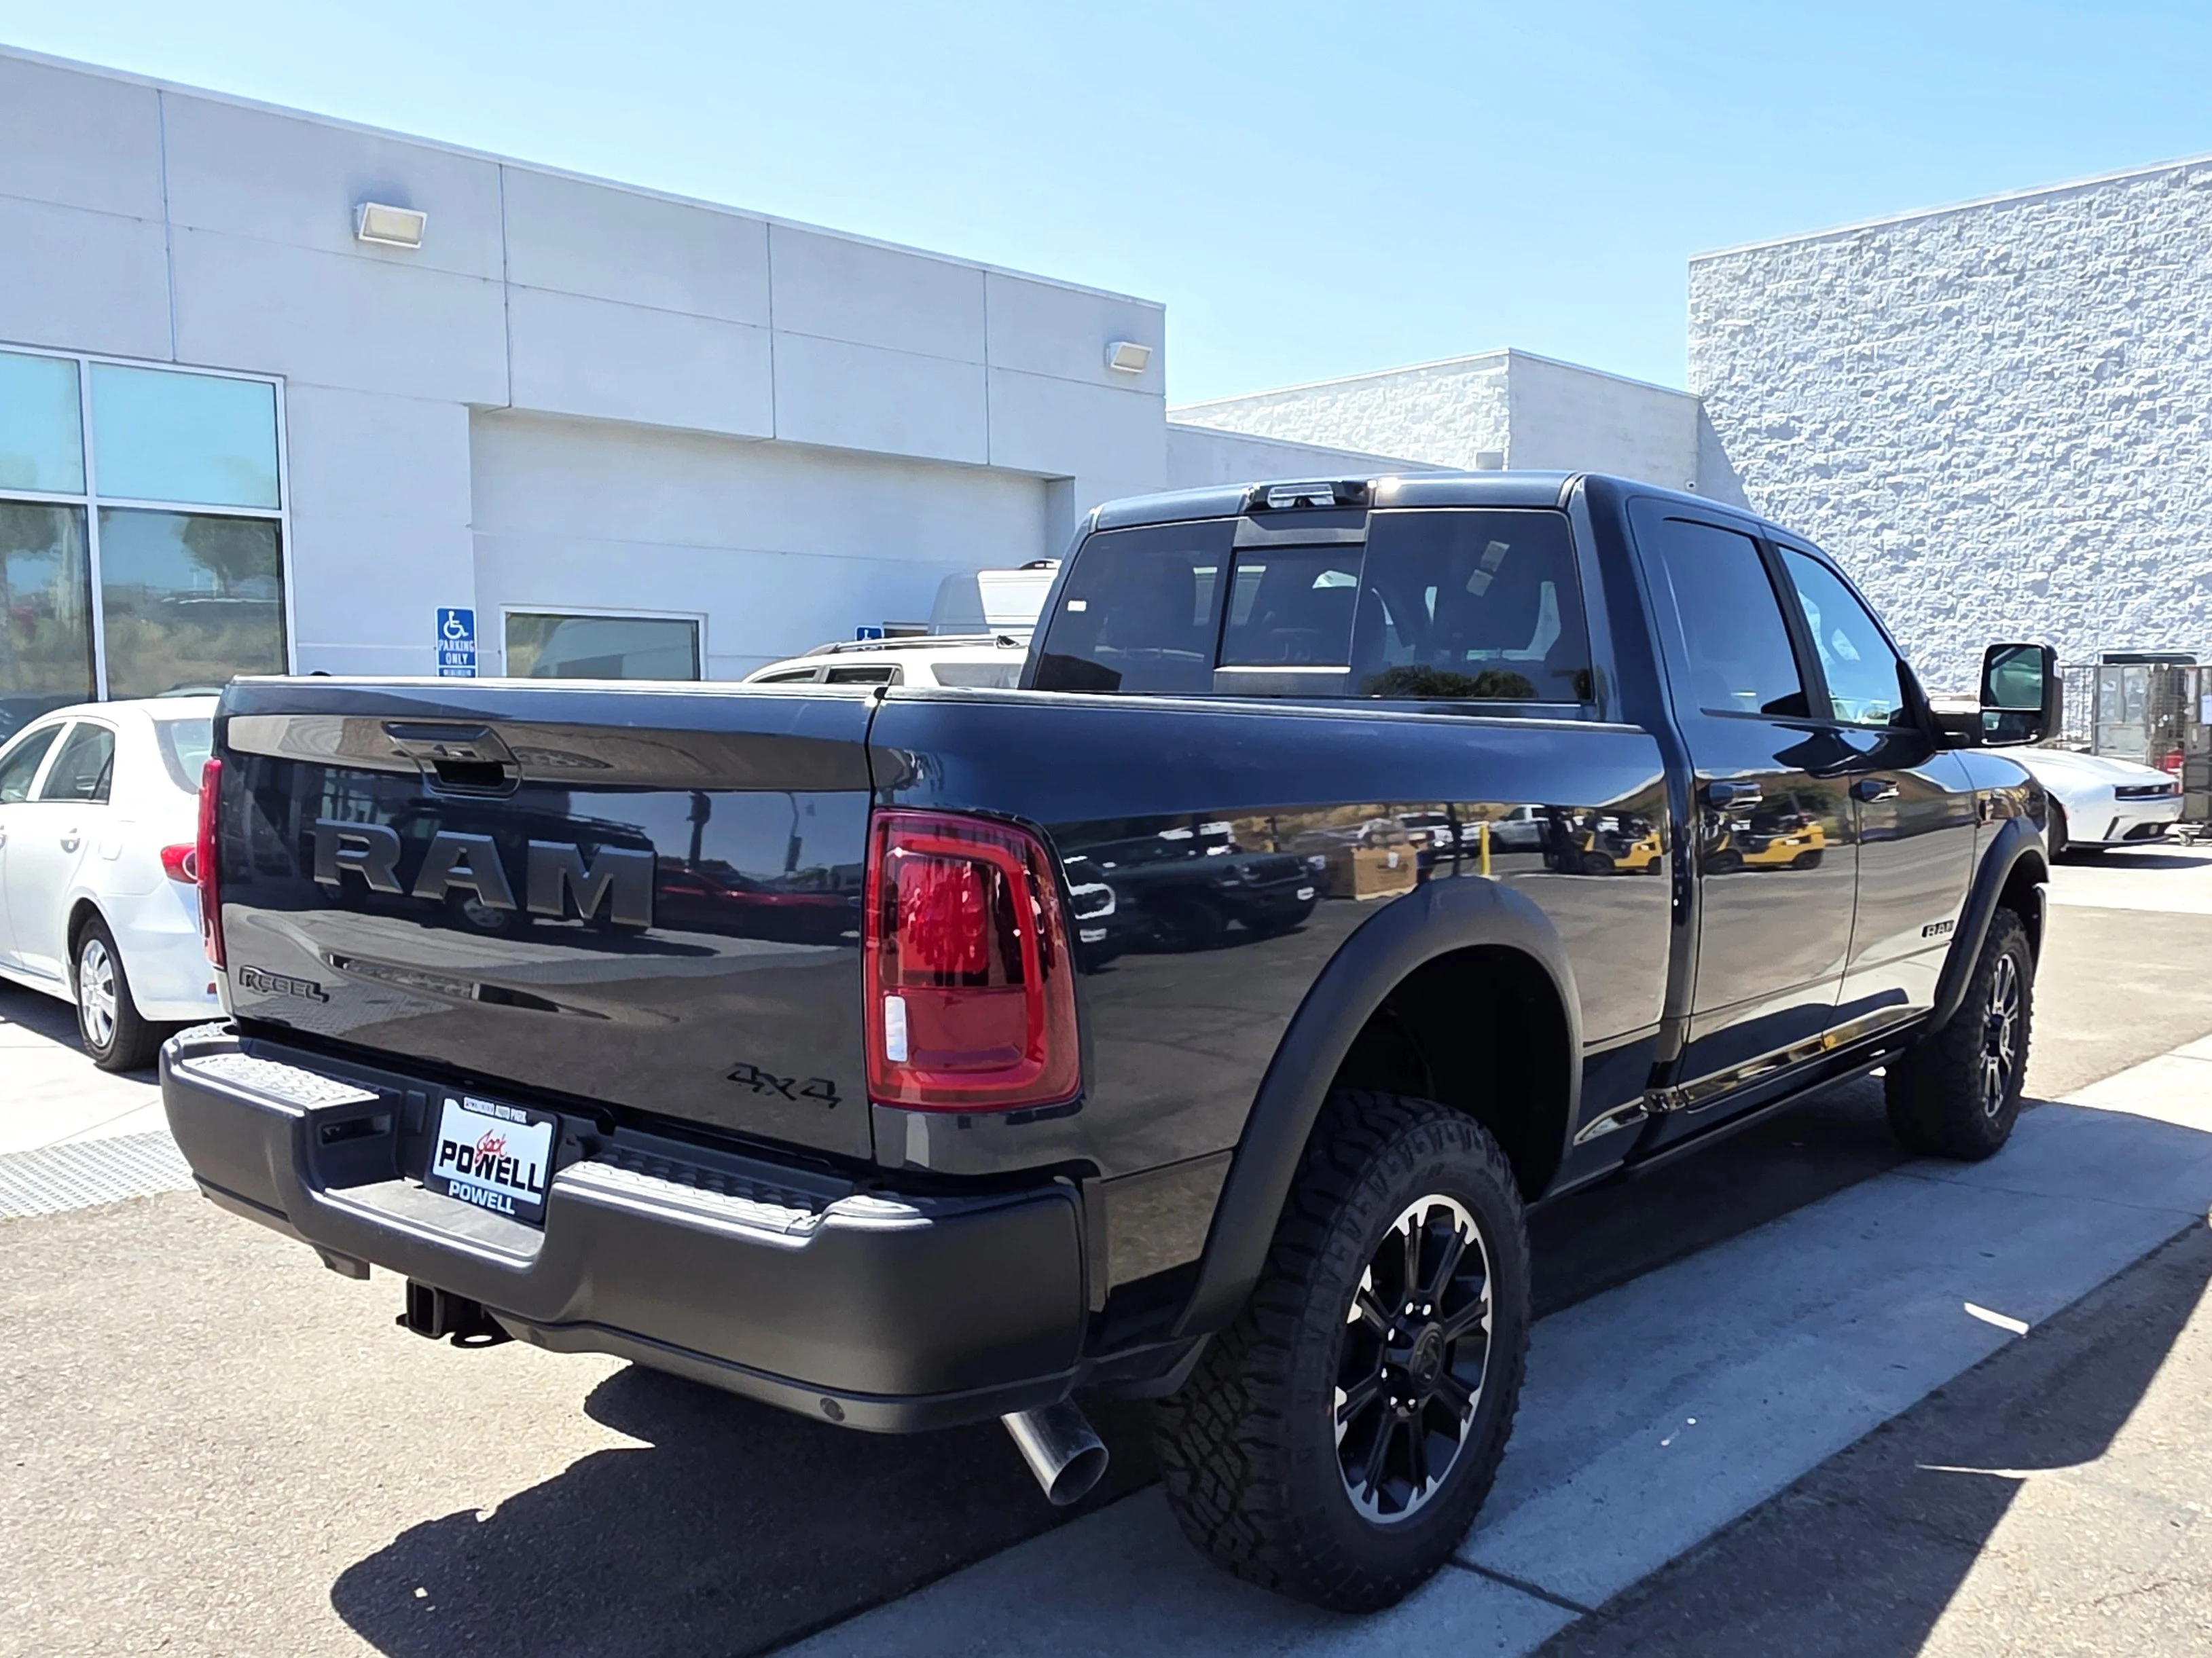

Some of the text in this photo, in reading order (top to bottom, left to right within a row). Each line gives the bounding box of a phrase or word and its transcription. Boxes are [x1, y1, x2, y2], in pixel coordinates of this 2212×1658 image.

[438, 640, 475, 652] PARKING
[446, 652, 468, 665] ONLY
[314, 818, 655, 930] RAM
[239, 965, 329, 1003] REBEL
[439, 1139, 543, 1194] POWELL
[448, 1180, 515, 1215] POWELL
